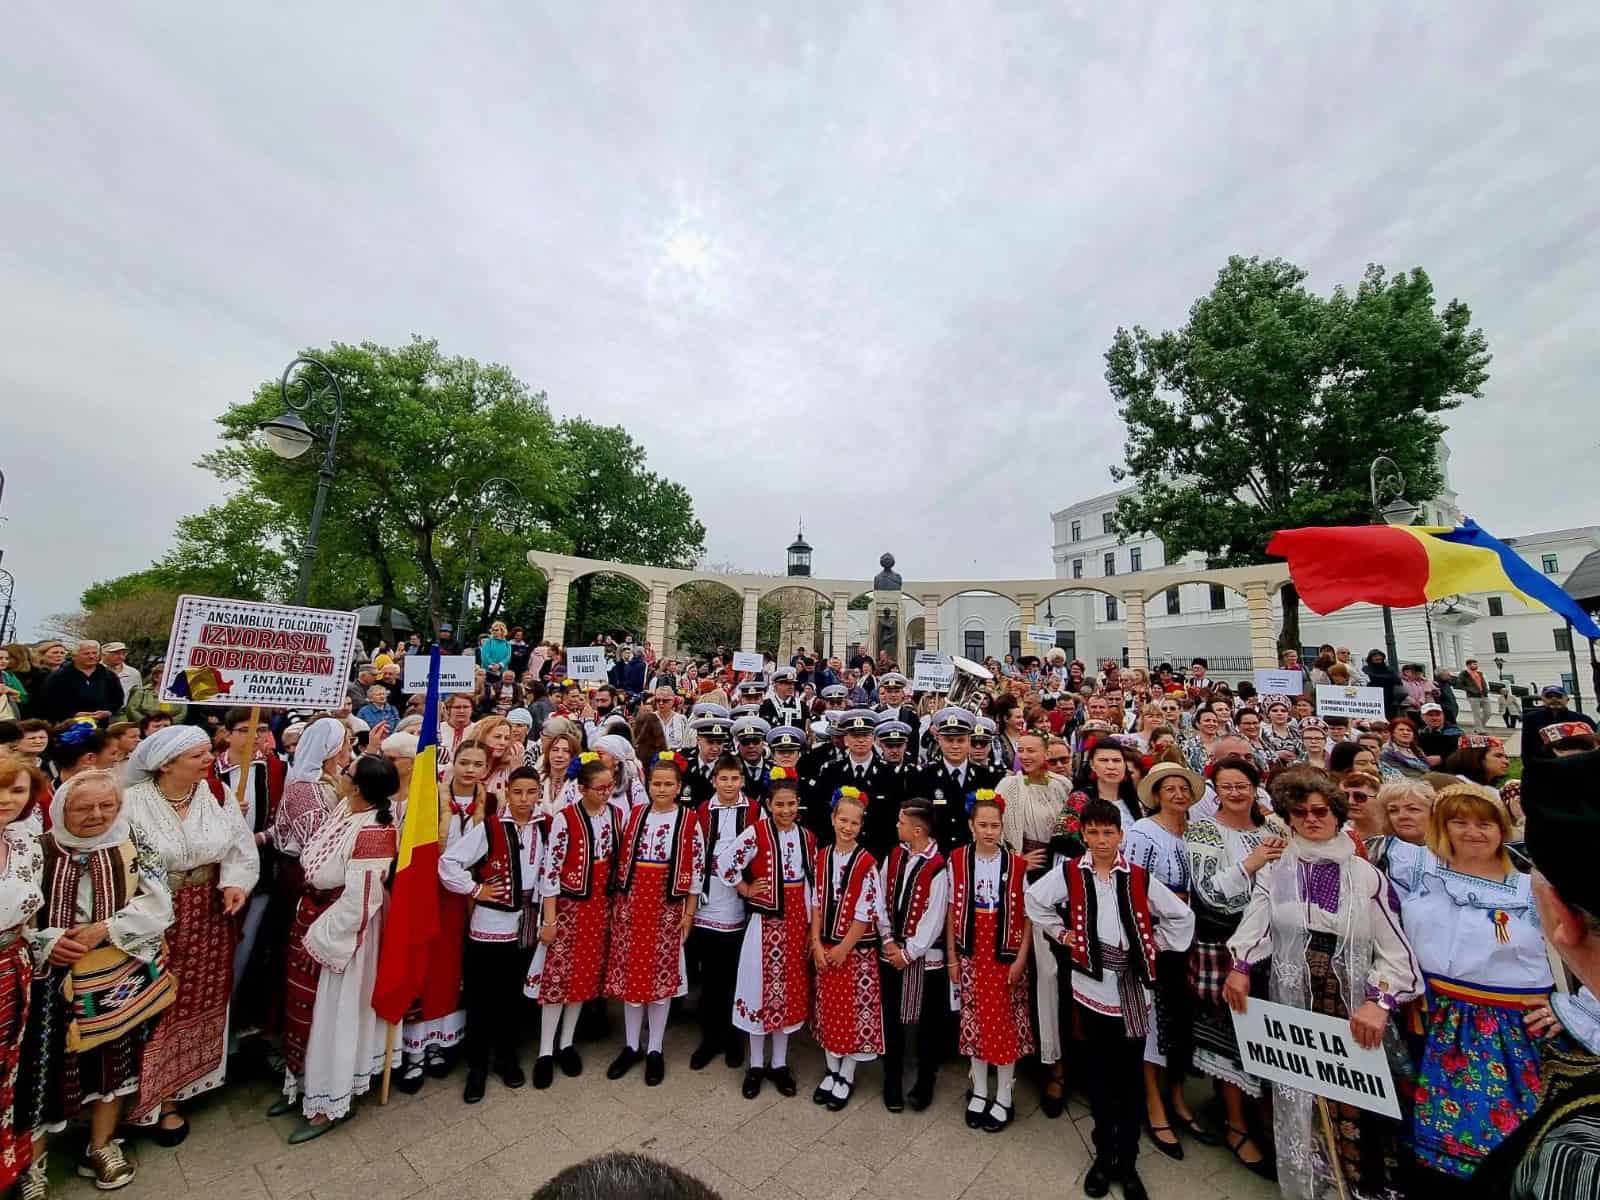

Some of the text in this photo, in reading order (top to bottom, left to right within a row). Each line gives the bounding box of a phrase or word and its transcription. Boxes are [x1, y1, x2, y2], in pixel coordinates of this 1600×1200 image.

[207, 611, 333, 634] ANSAMBLUL FOLCLORIC
[190, 646, 334, 676] DOBROGEAN
[248, 683, 305, 695] ROMÂNIA
[1289, 1024, 1317, 1049] DE
[1319, 1032, 1349, 1058] LA
[1246, 1041, 1386, 1099] MALUL MĂRII
